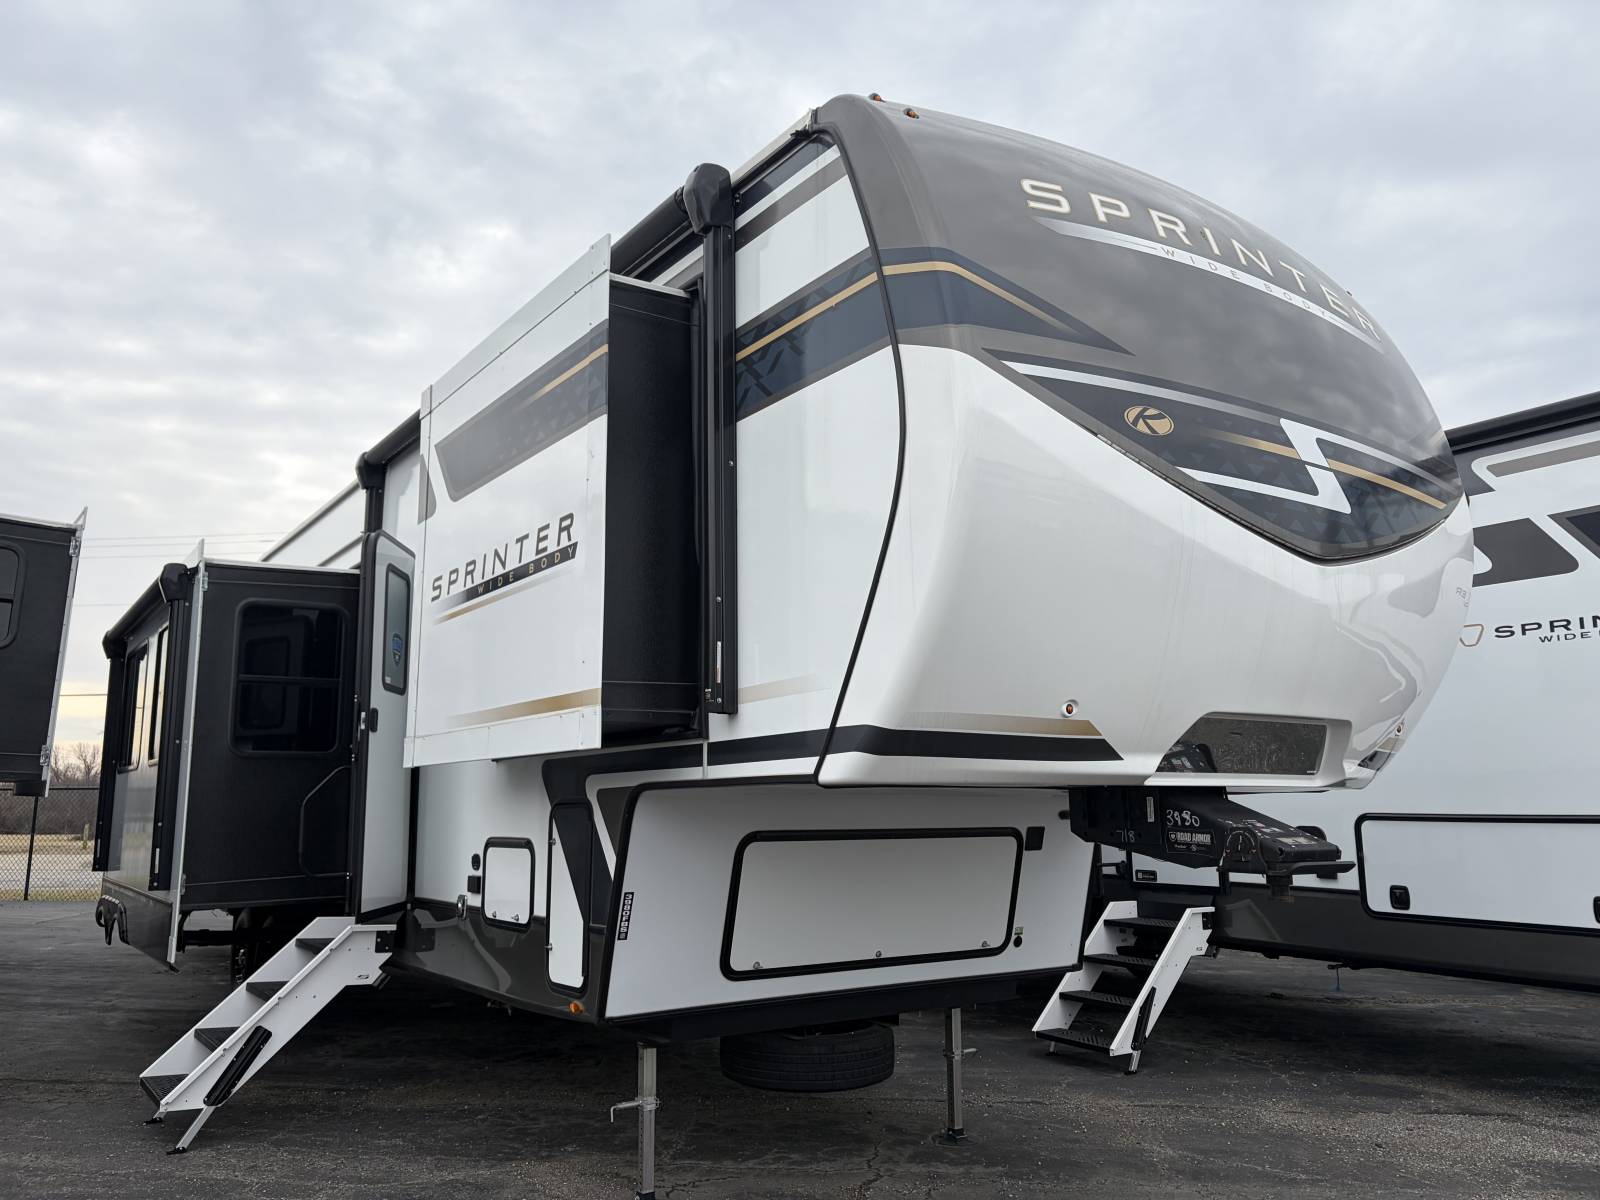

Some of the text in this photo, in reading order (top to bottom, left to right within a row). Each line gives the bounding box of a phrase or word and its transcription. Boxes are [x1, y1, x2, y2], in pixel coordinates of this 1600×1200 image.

[1020, 178, 1382, 342] SPRINTER
[1161, 246, 1328, 317] WIDE BODY
[431, 512, 574, 602] SPRINTER
[477, 546, 574, 594] WIDE BODY
[1539, 632, 1592, 643] WIDE
[1166, 809, 1200, 827] 3980
